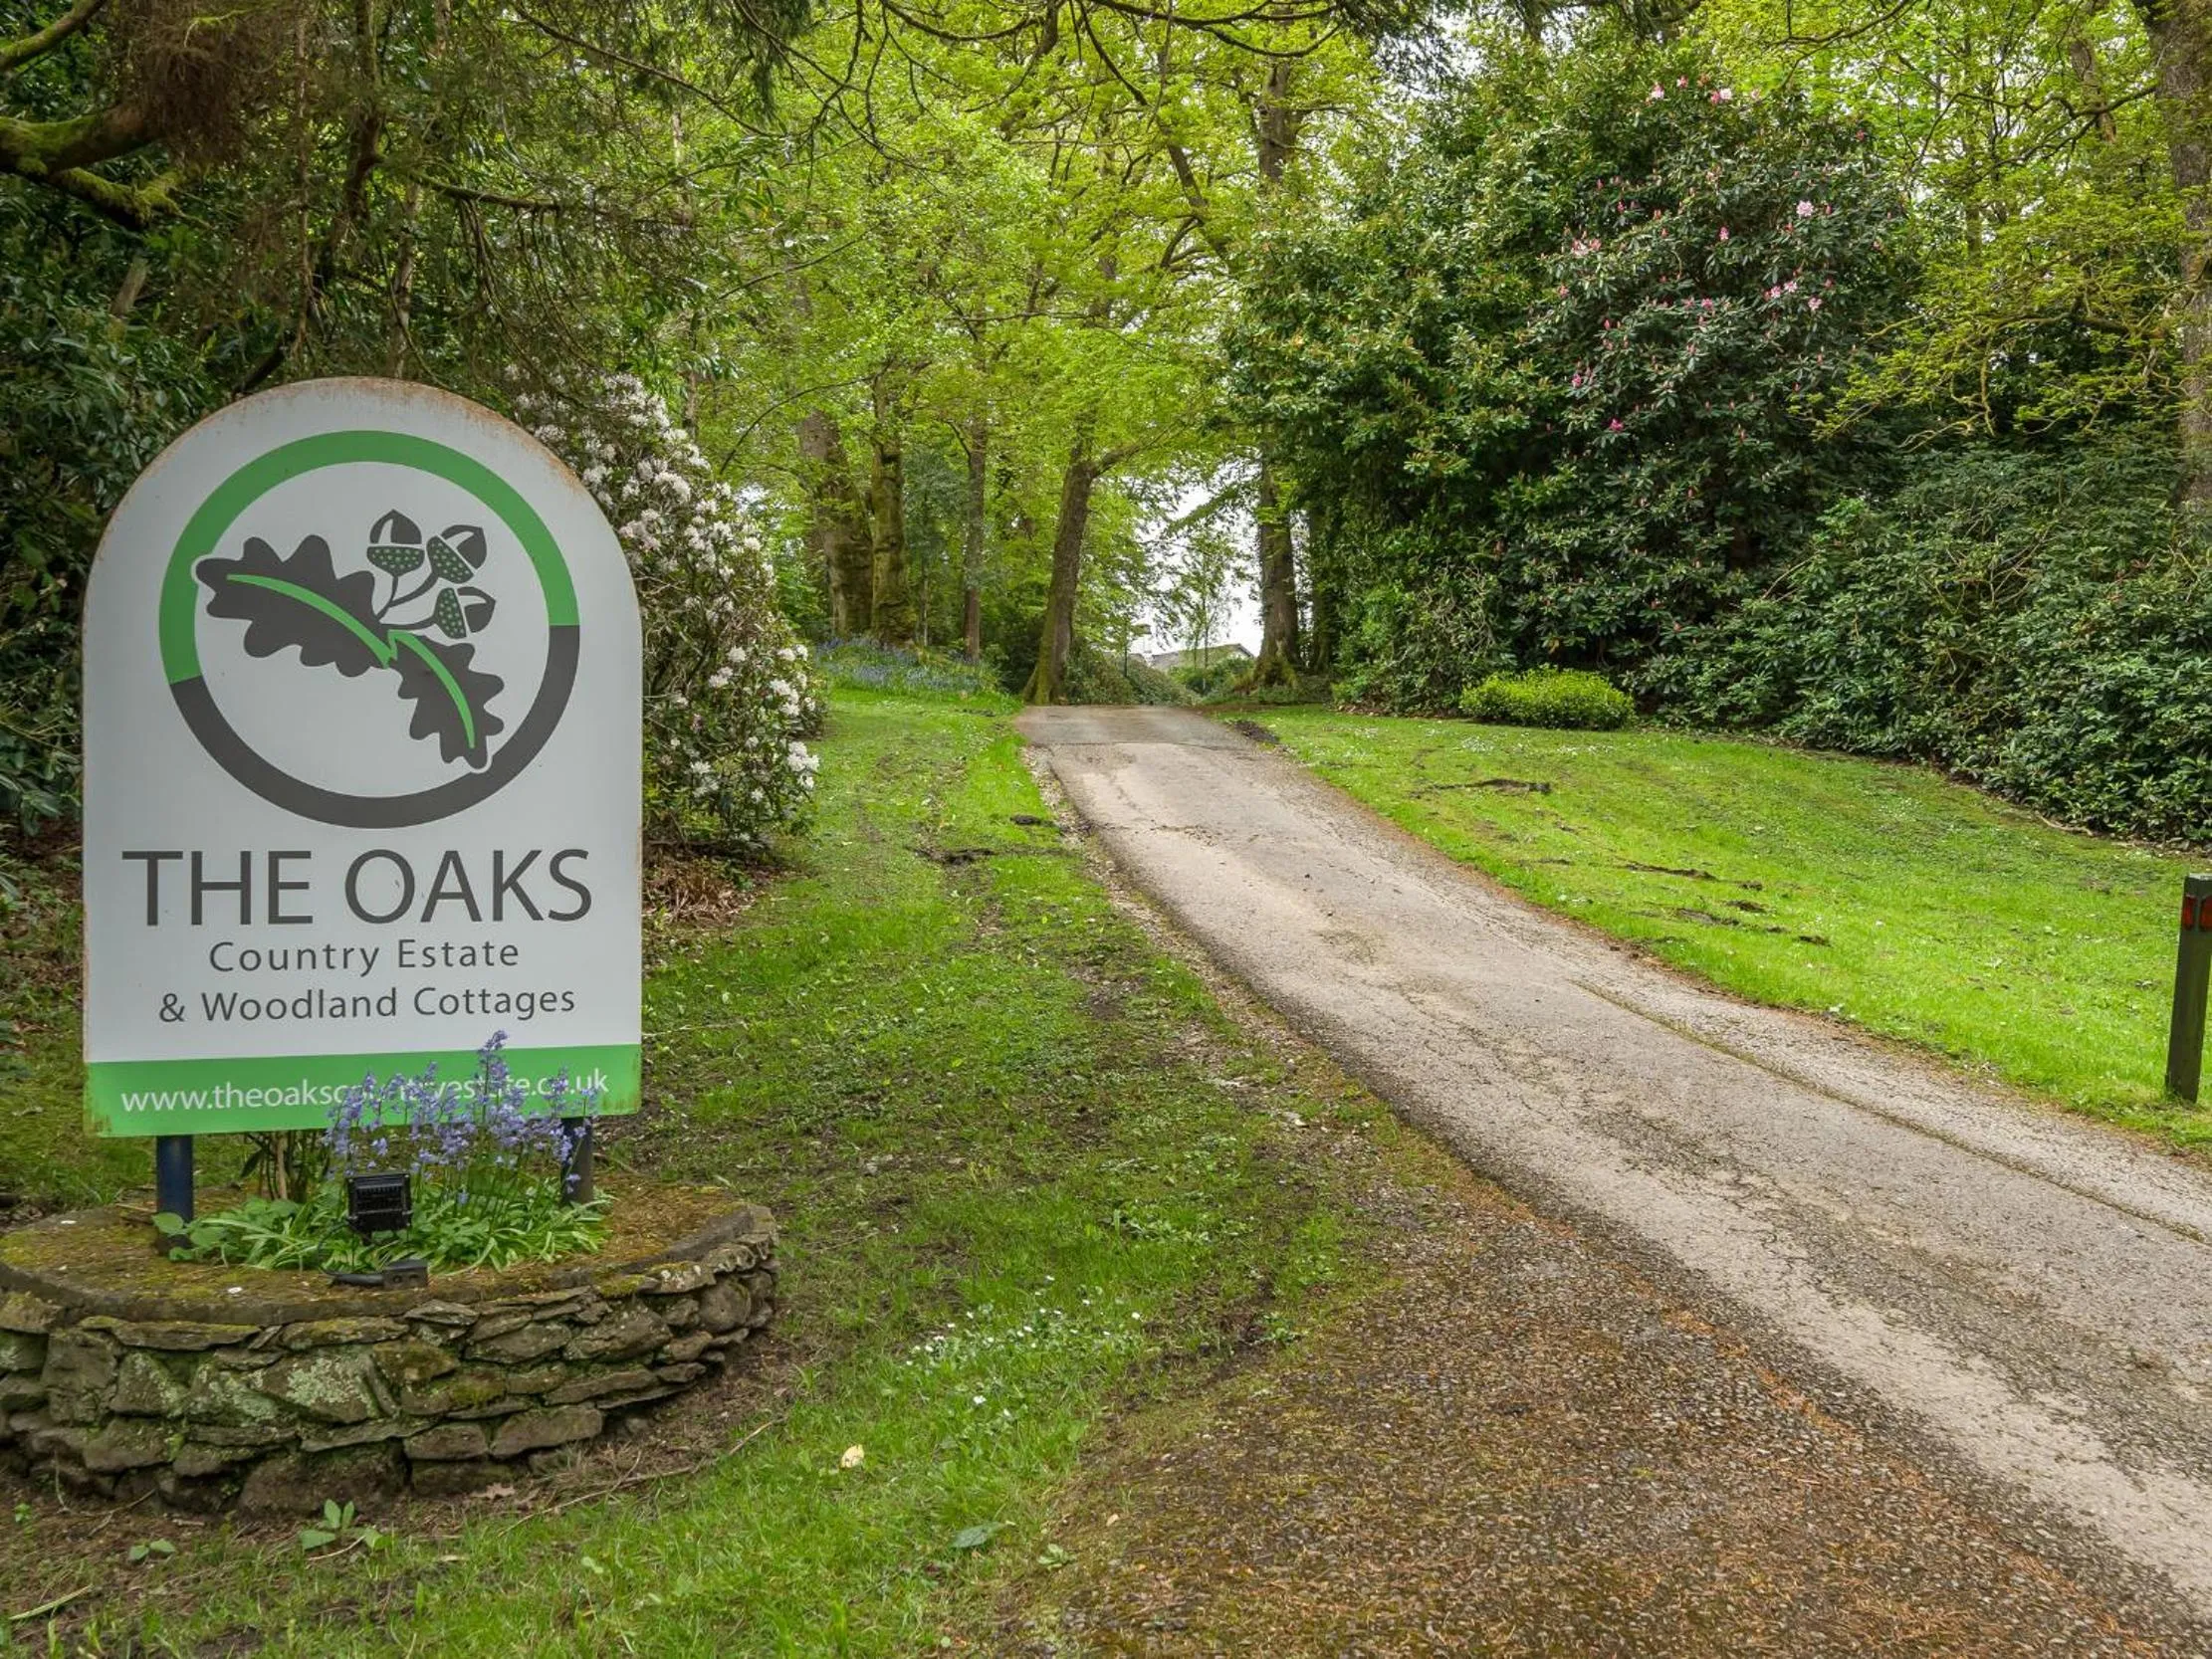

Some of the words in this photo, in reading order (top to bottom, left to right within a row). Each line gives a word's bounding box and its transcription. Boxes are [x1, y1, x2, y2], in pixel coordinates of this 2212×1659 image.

[120, 850, 314, 927] THE
[344, 848, 592, 925] OAKS
[209, 940, 380, 978] Country
[398, 938, 520, 968] Estate
[158, 992, 186, 1023] &
[201, 986, 397, 1022] Woodland
[413, 986, 575, 1021] Cottages
[120, 1068, 609, 1113] www.theoaksctyeste.c.uk
